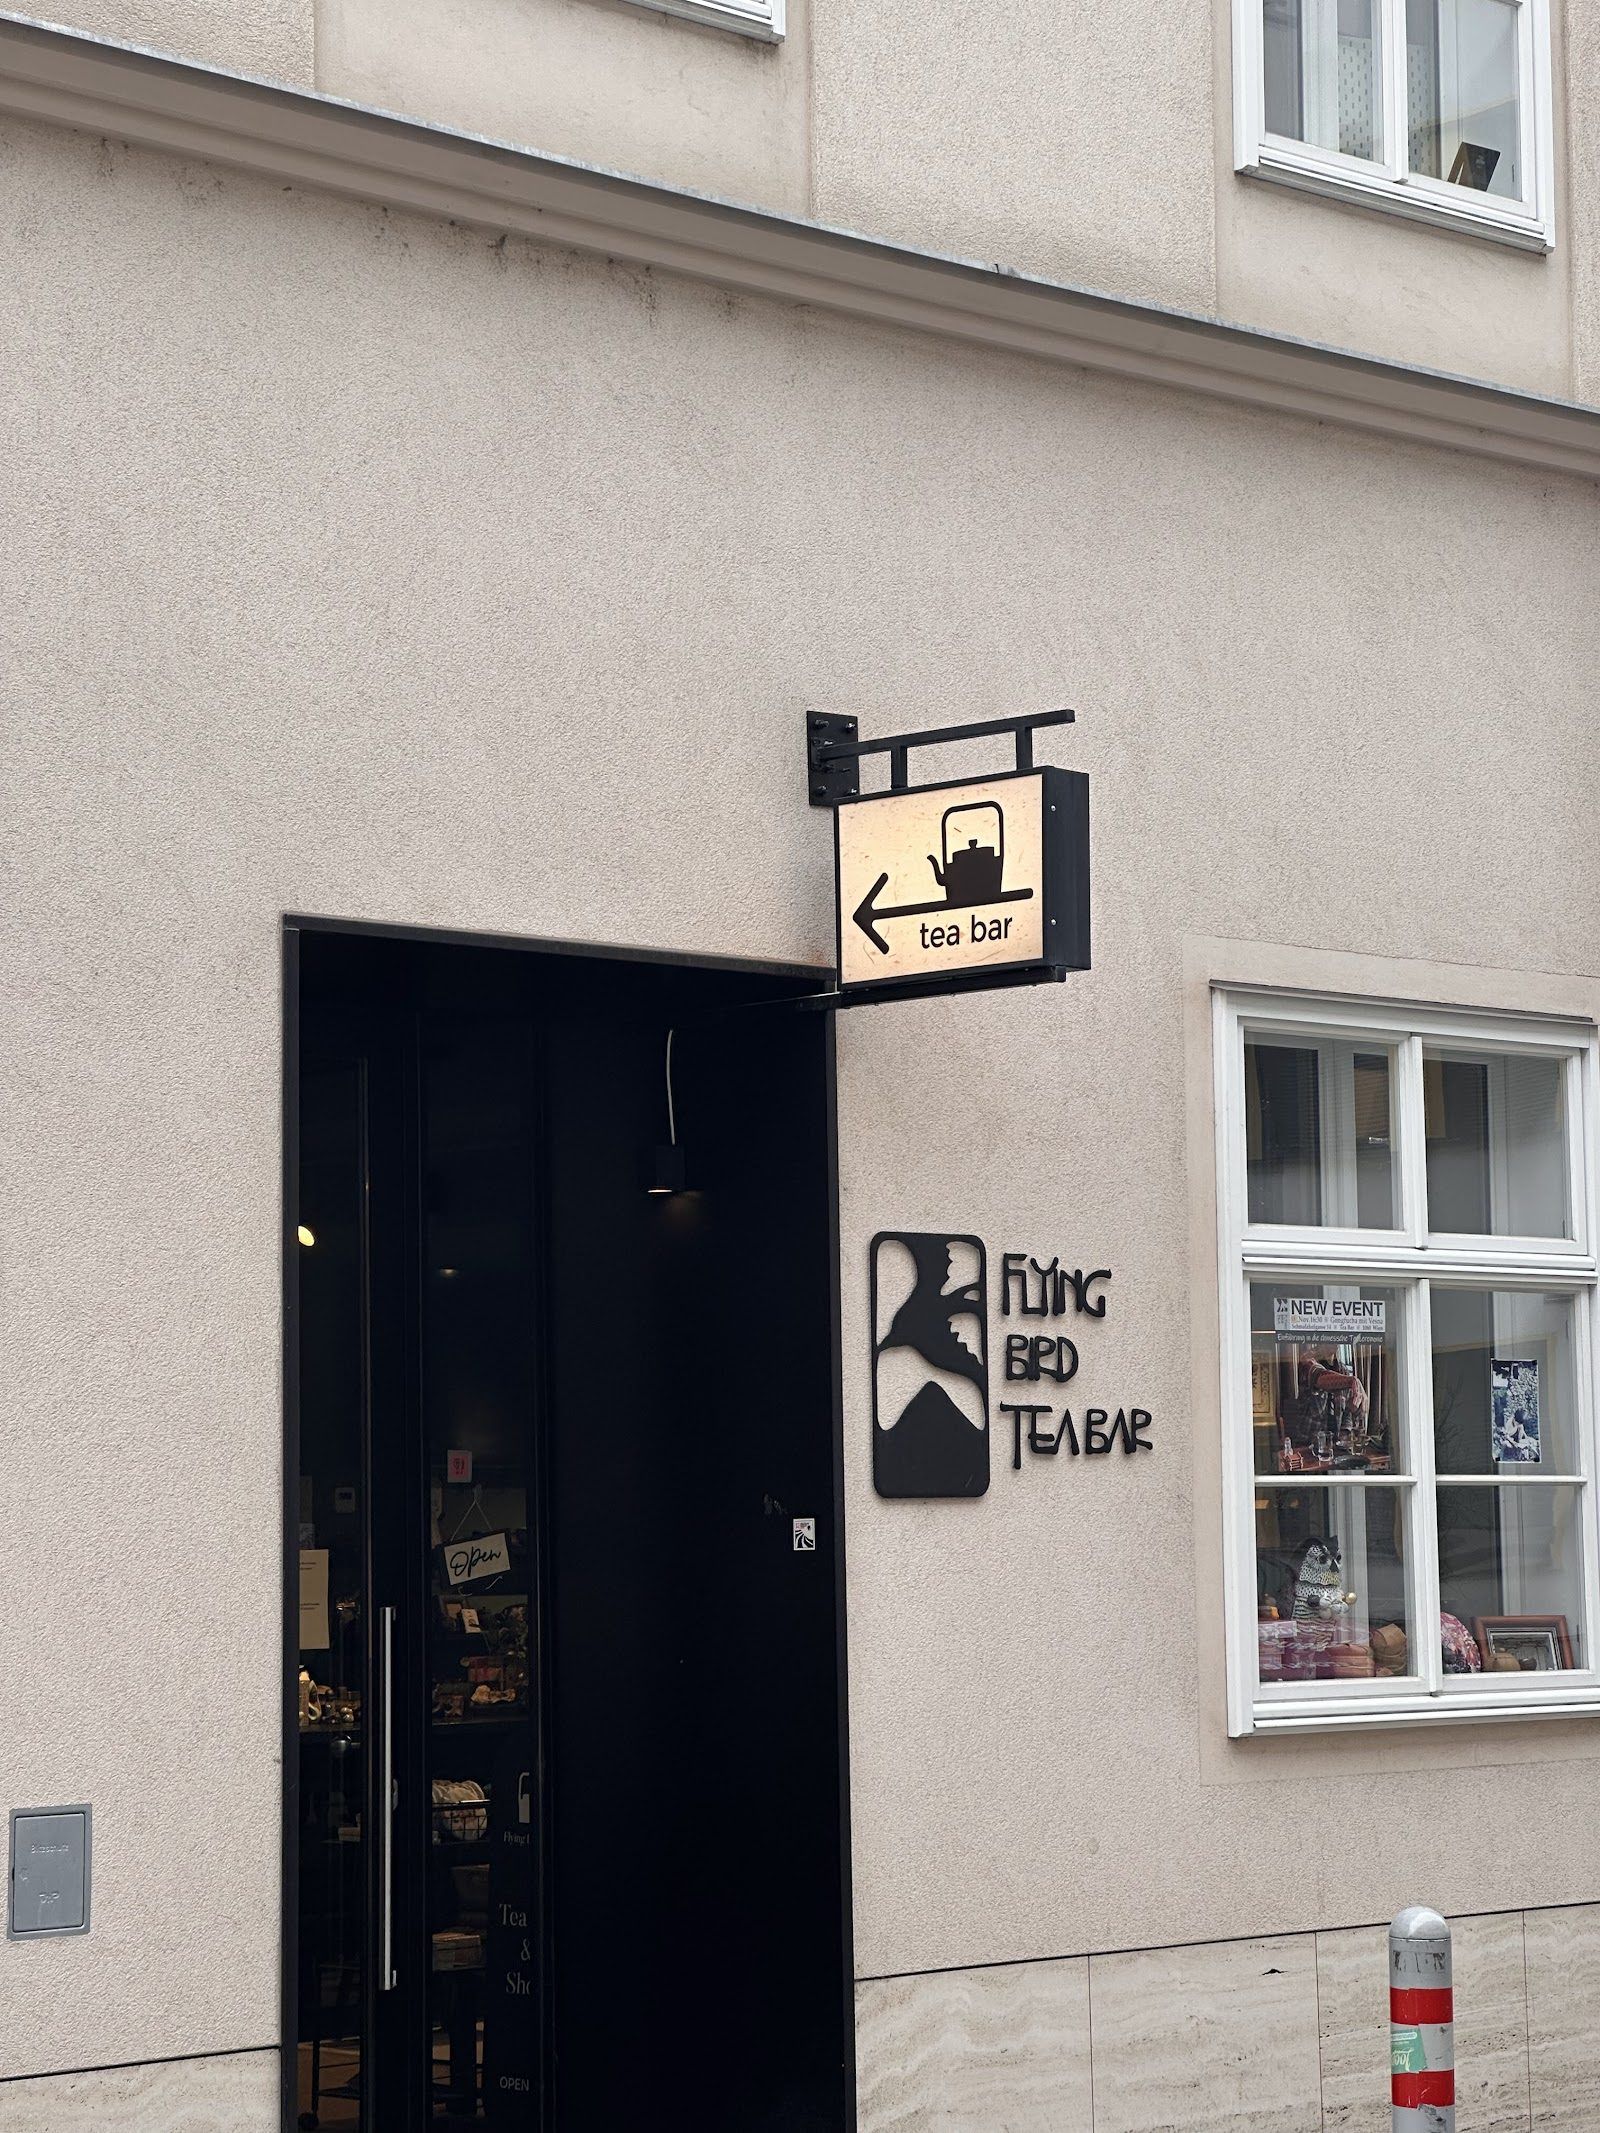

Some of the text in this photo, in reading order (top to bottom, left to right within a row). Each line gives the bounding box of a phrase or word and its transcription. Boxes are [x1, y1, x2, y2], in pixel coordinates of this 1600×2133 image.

[919, 914, 1013, 950] tea bar
[1002, 1252, 1112, 1318] FLYING
[1291, 1299, 1383, 1317] NEW EVENT
[1005, 1334, 1078, 1382] BIRD
[1000, 1401, 1153, 1469] TEA BAR
[450, 1546, 501, 1578] Open
[499, 1903, 527, 1927] Tea
[499, 2076, 529, 2092] OPEN
